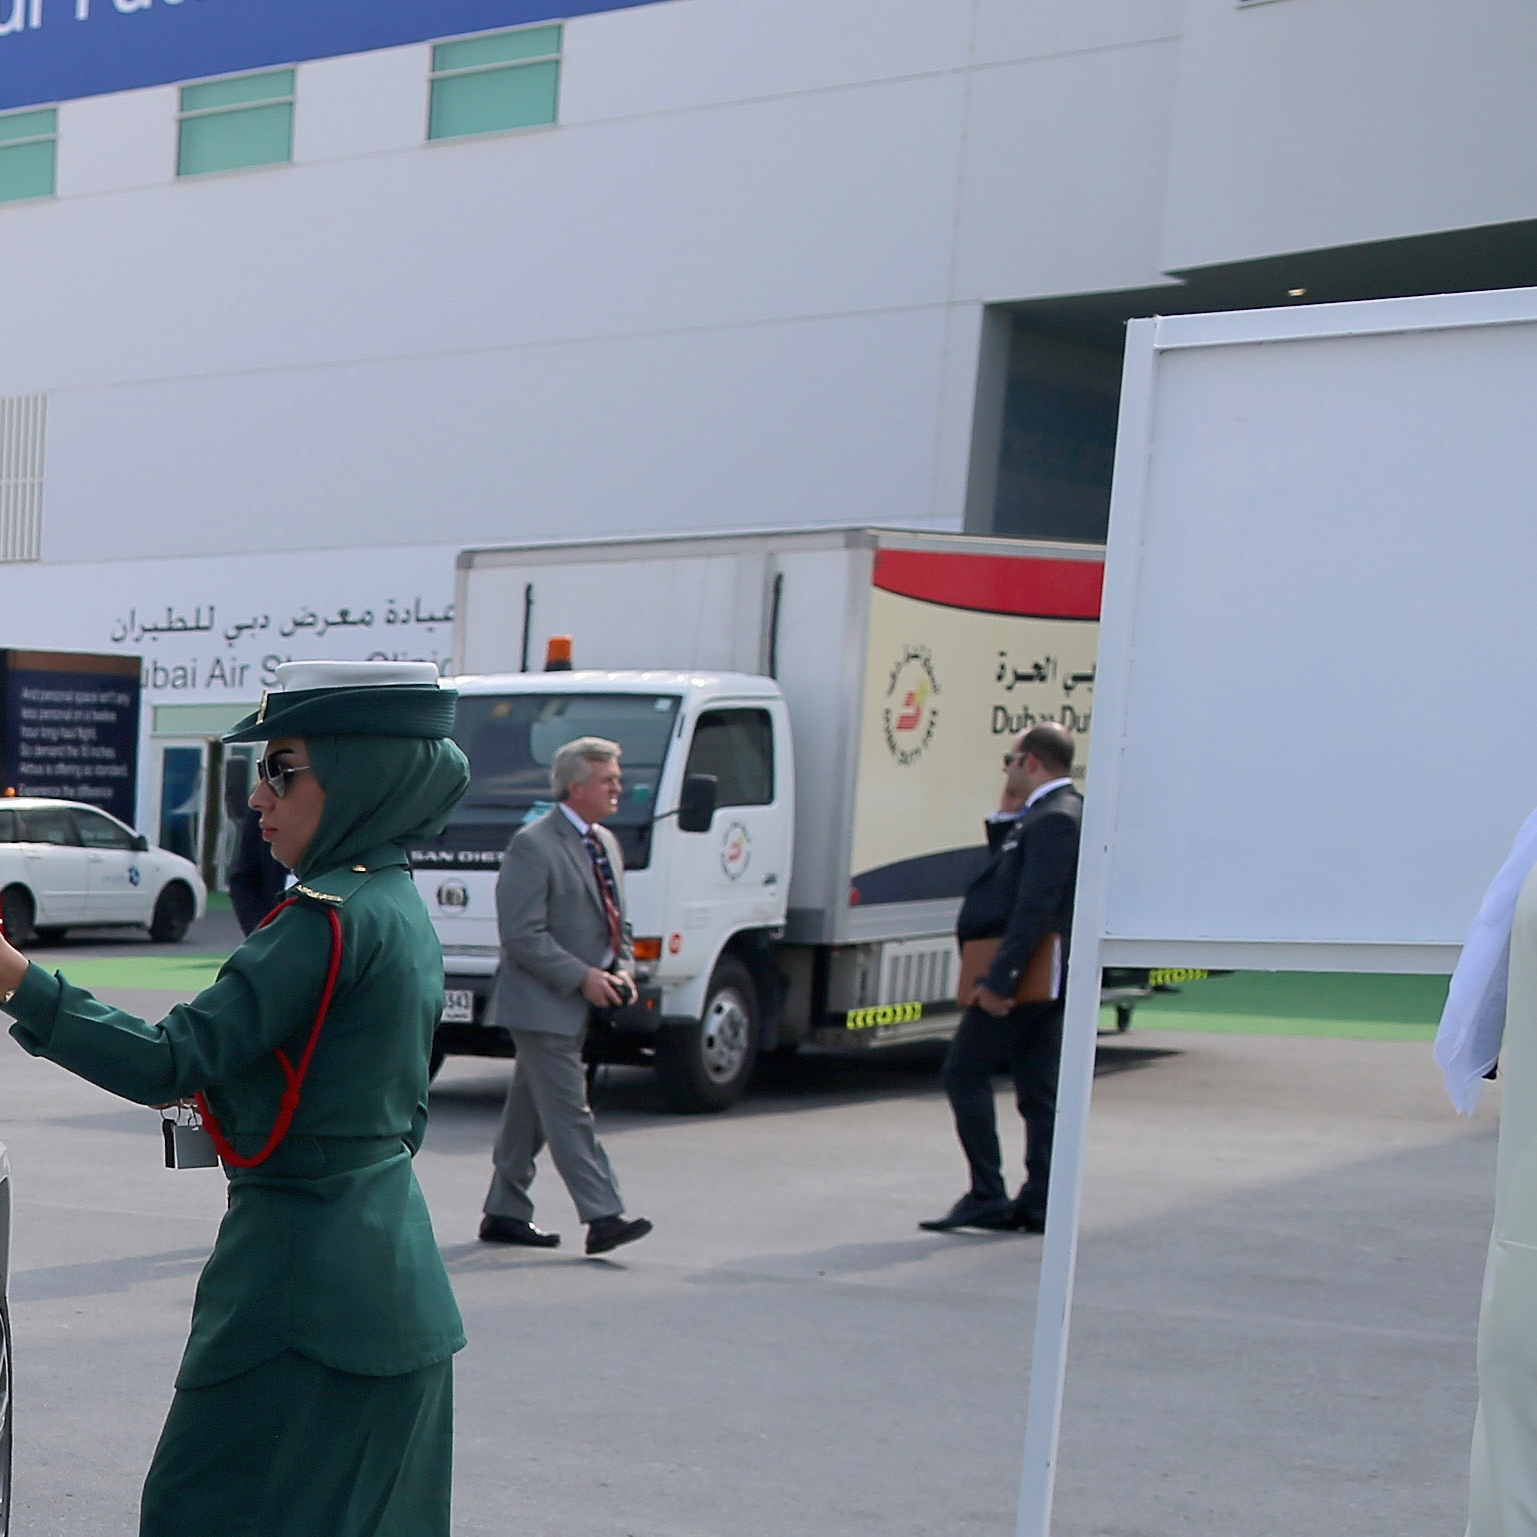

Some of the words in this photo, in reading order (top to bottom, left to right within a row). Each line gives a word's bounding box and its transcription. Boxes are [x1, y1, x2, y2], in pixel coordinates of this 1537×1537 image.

[110, 605, 216, 643] للطيران
[223, 612, 271, 648] دبي
[279, 606, 374, 638] معرض
[141, 657, 197, 690] ubai
[205, 657, 250, 689] Air
[995, 649, 1058, 691] الحرة
[1063, 661, 1096, 698] بي
[411, 850, 455, 862] SAN
[457, 850, 505, 862] DIE
